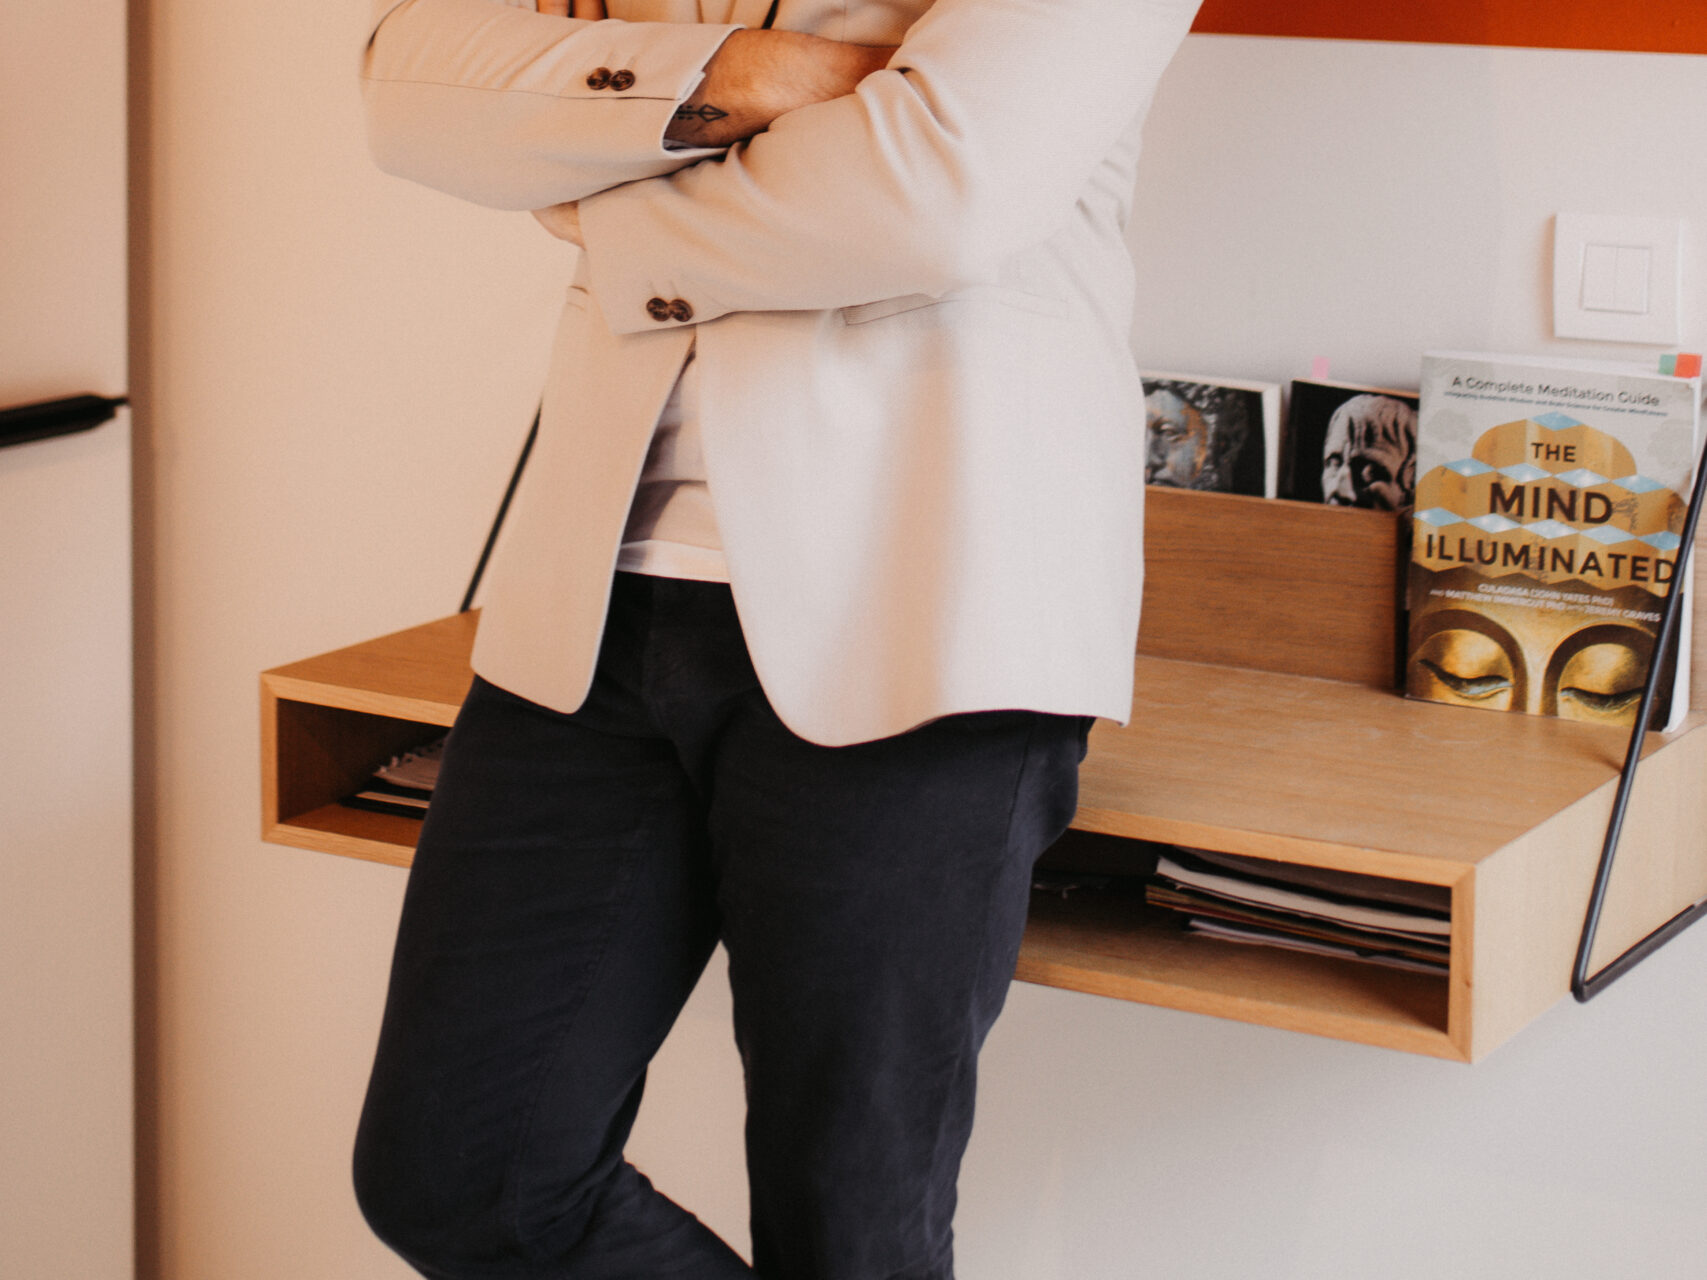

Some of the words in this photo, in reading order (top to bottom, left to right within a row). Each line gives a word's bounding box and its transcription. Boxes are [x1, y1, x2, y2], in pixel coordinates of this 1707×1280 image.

[1452, 376, 1462, 386] A
[1466, 377, 1533, 394] Complete
[1538, 384, 1614, 402] Meditation
[1617, 391, 1661, 407] Guide
[1531, 442, 1577, 463] THE
[1489, 482, 1614, 524] MIND
[1425, 534, 1675, 585] ILLUMINATED
[1622, 609, 1662, 622] GRAVES
